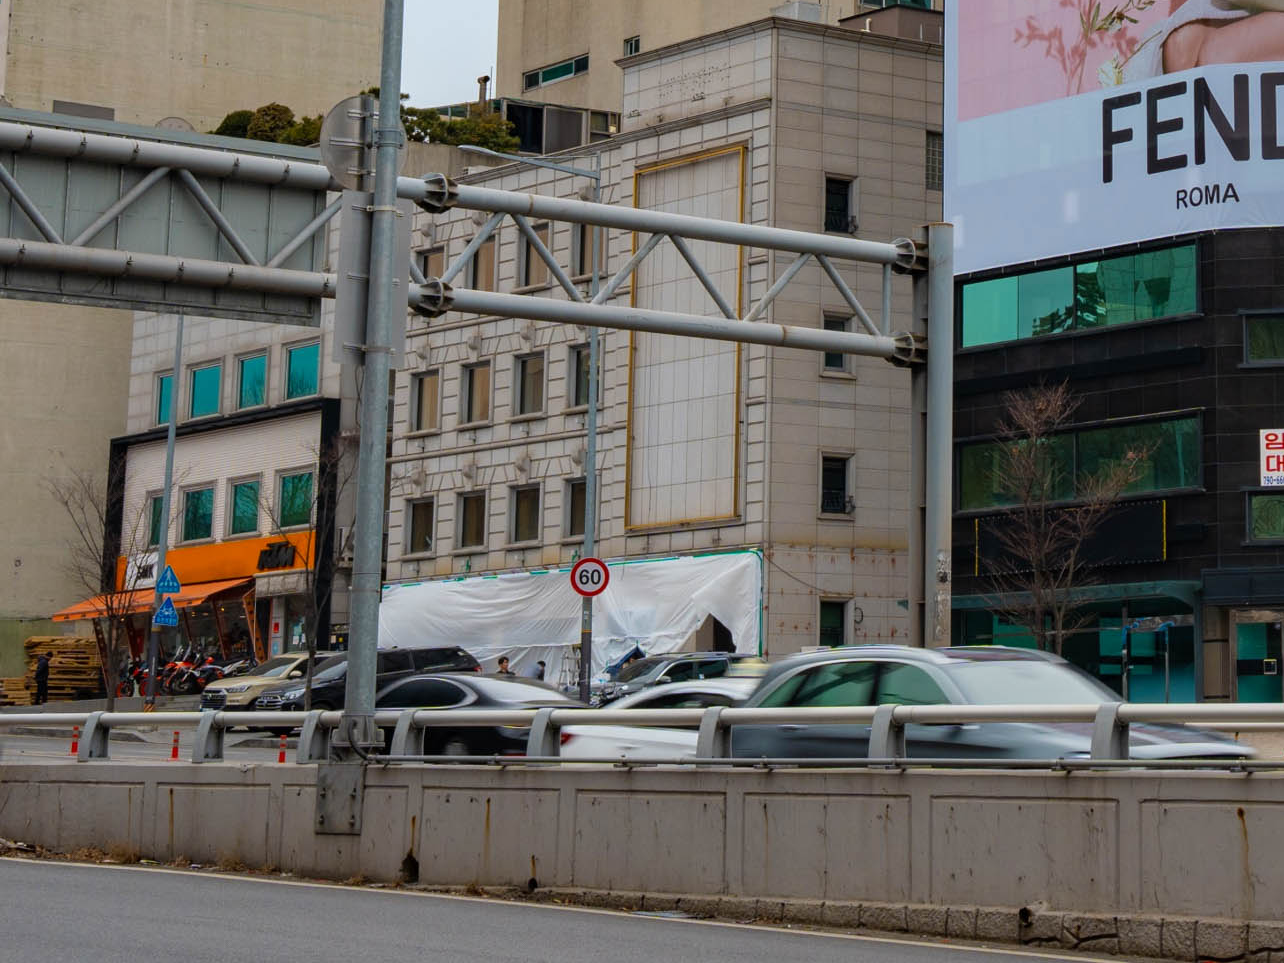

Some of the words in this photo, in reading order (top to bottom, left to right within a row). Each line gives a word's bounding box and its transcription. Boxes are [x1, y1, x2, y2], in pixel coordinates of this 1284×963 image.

[1176, 183, 1240, 210] ROMA
[257, 541, 296, 571] KTM
[579, 569, 602, 585] 60
